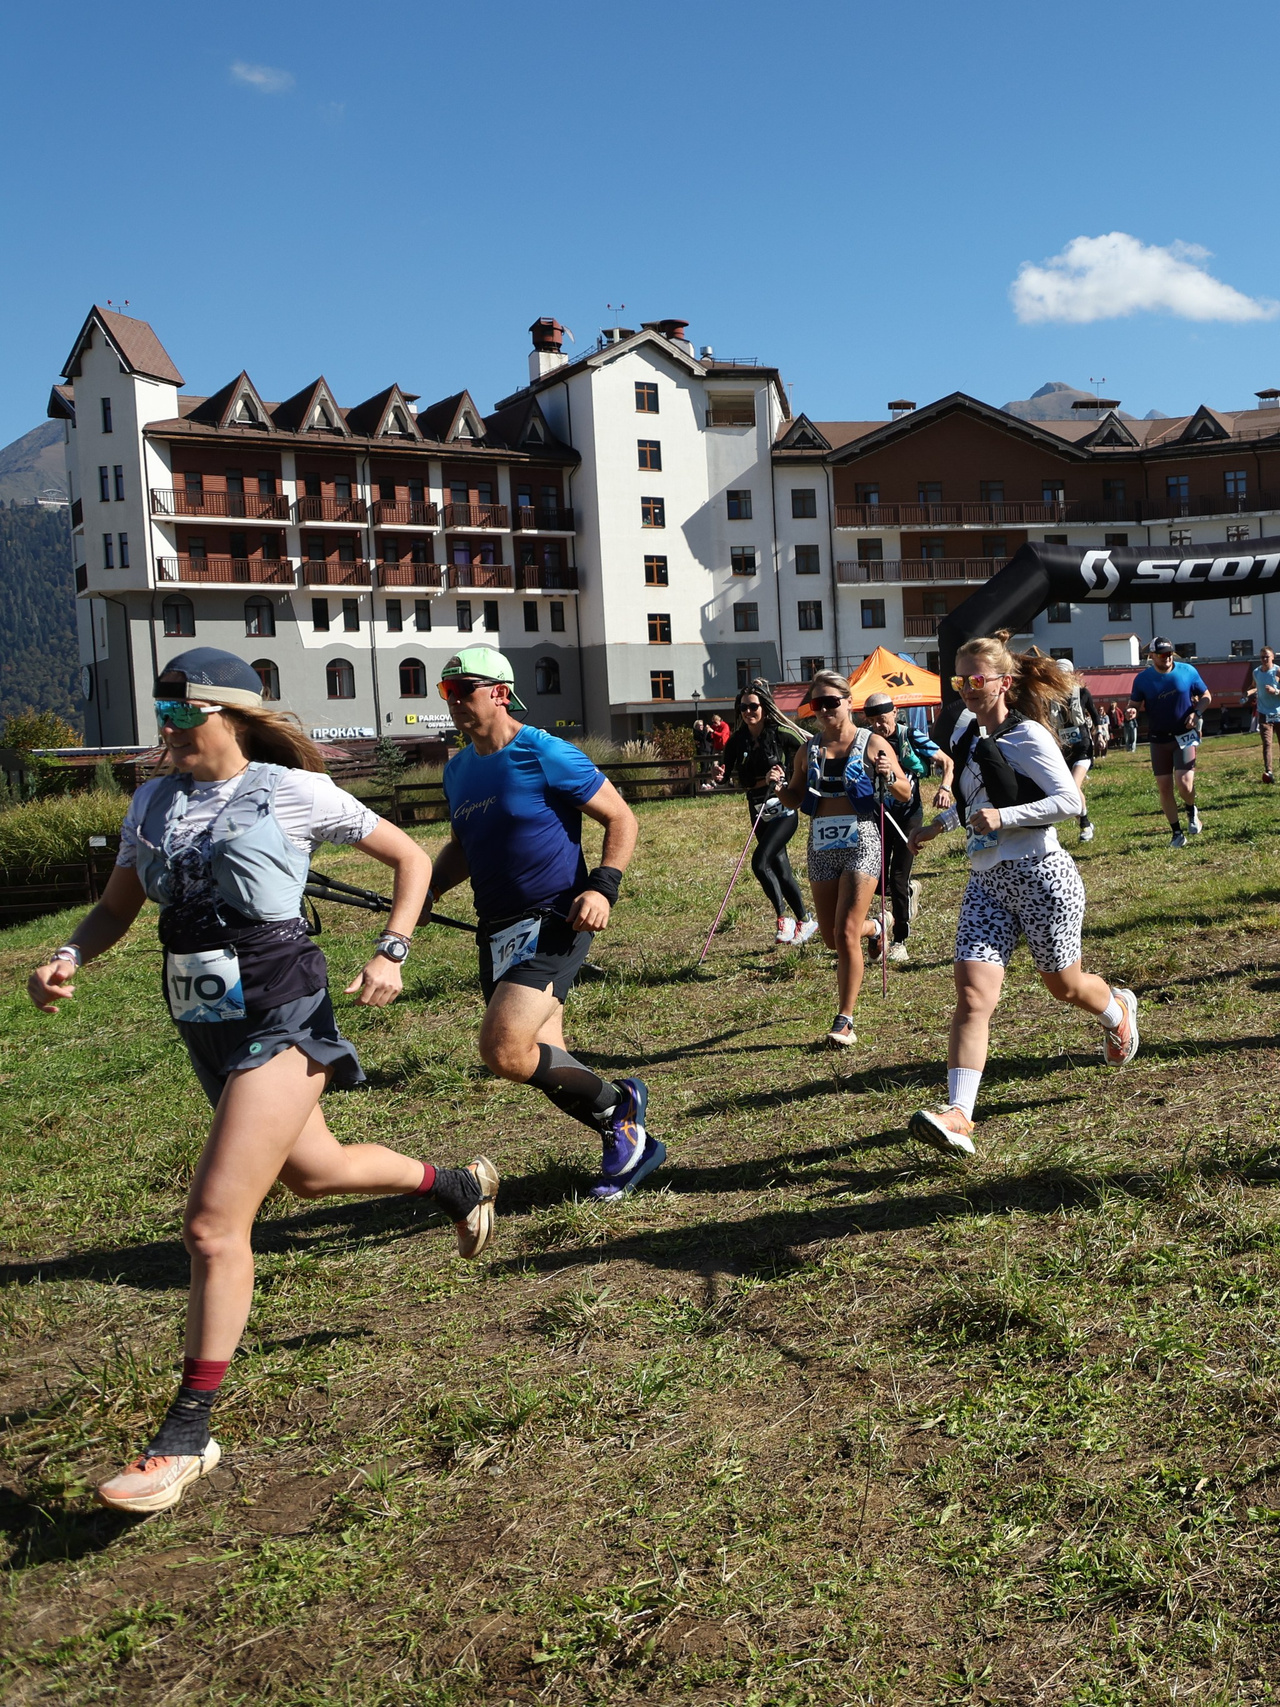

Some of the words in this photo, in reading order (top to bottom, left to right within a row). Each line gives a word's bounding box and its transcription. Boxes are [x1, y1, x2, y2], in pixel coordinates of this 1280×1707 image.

[313, 727, 360, 738] ПРОКАТ
[1181, 733, 1196, 742] 174
[817, 825, 852, 840] 137
[497, 930, 533, 964] 167
[170, 973, 227, 1002] 170
